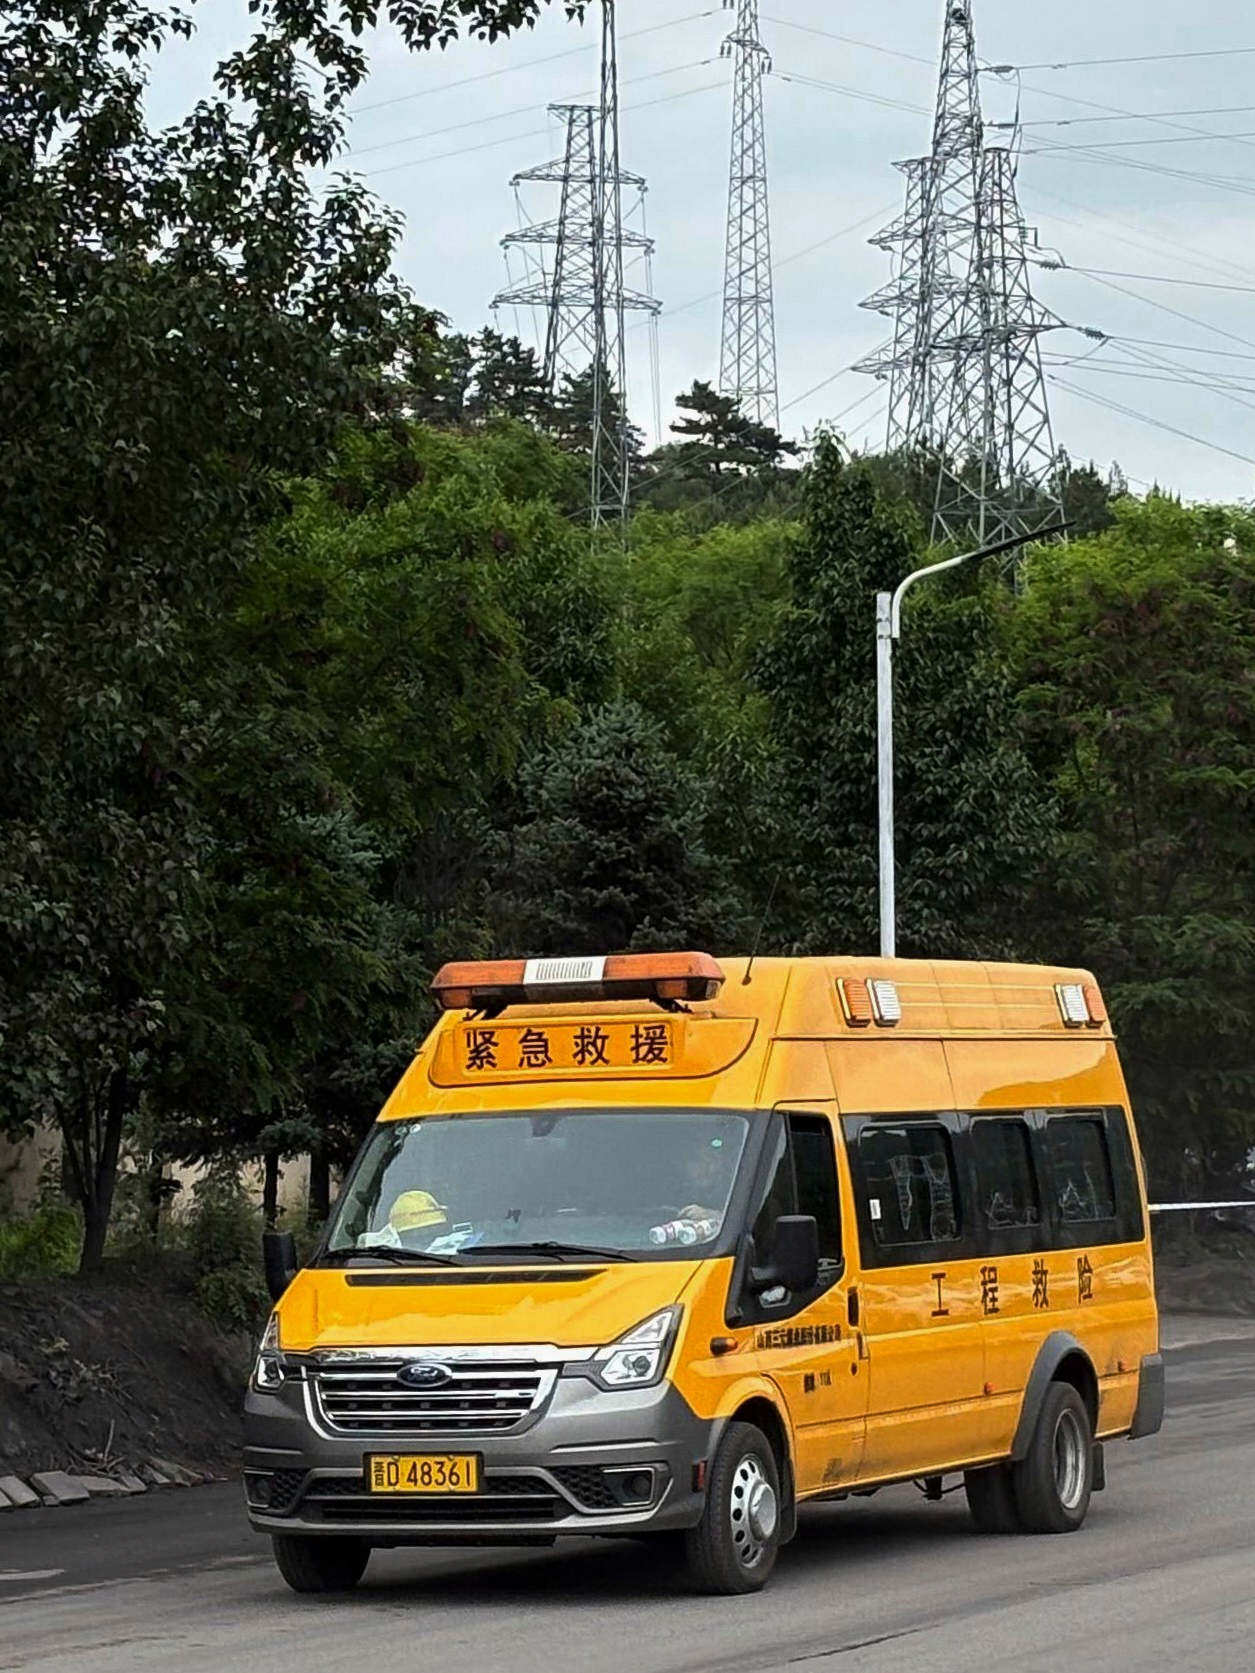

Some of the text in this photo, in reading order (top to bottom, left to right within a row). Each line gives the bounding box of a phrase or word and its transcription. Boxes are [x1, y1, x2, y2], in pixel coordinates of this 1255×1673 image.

[465, 1025, 669, 1071] 紧急救援
[931, 1254, 1094, 1317] 工程救险
[373, 1460, 471, 1487] 晋D48361
